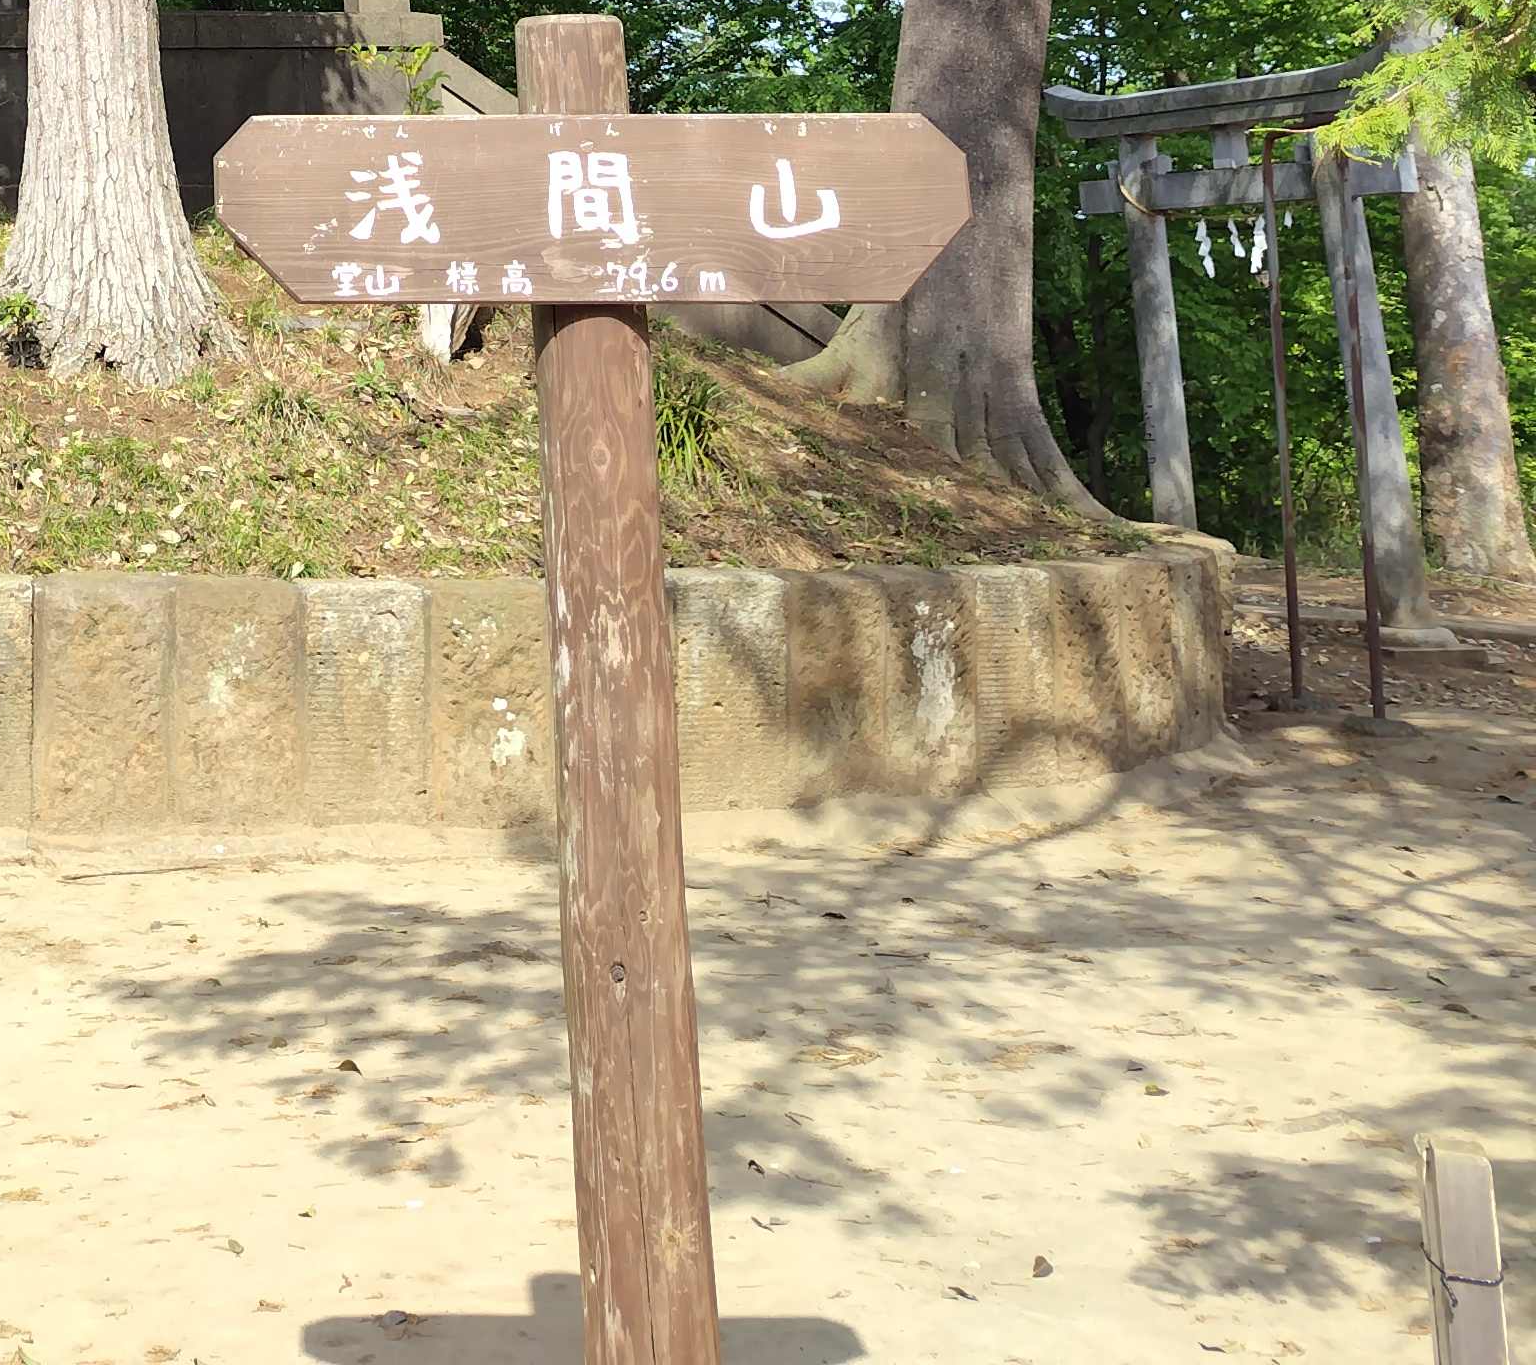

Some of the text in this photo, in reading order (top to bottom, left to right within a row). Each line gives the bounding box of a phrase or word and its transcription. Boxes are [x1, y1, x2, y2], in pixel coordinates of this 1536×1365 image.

[345, 150, 841, 245] 浅間山
[331, 261, 400, 297] 堂山
[445, 259, 534, 296] 標高
[699, 270, 726, 293] m
